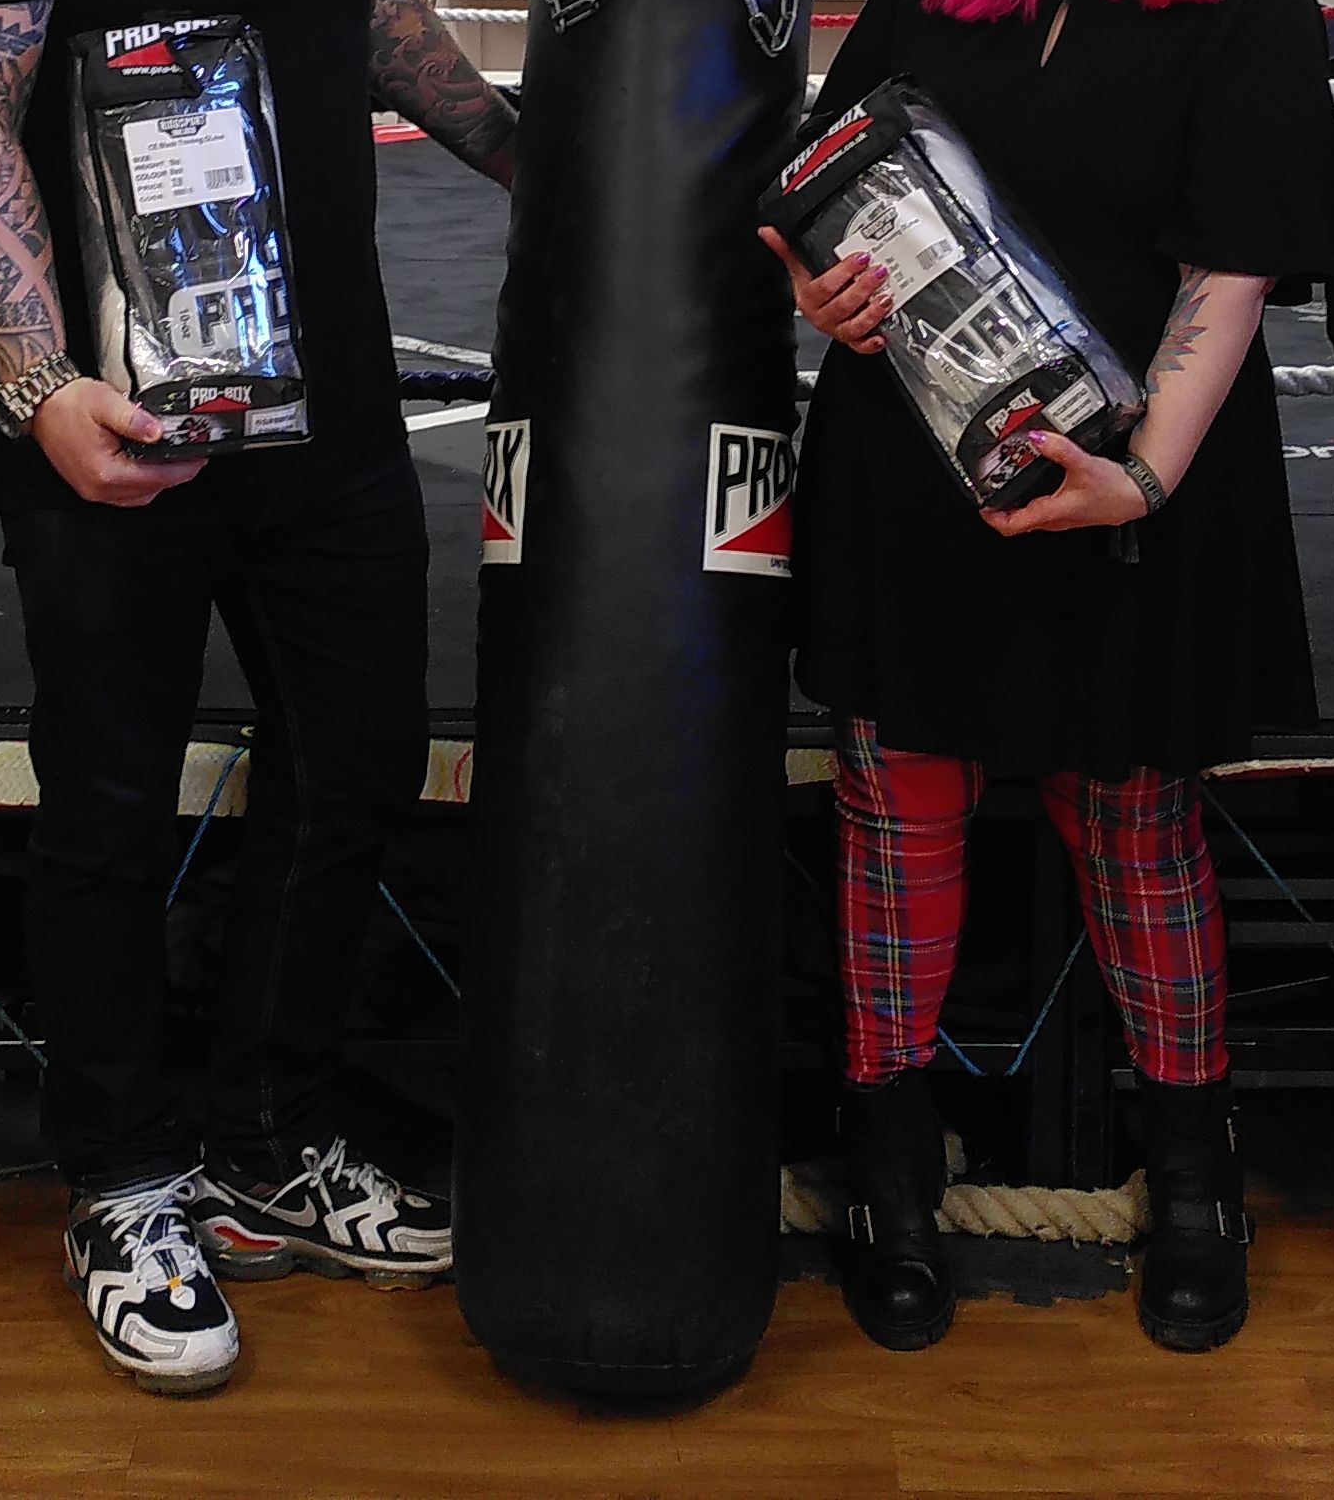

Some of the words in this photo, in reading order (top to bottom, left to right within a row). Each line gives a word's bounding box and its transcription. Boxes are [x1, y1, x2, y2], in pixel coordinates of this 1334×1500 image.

[780, 102, 869, 190] PRO-BOX
[189, 384, 253, 410] PRO-BOX
[984, 387, 1042, 440] PRO-BOX
